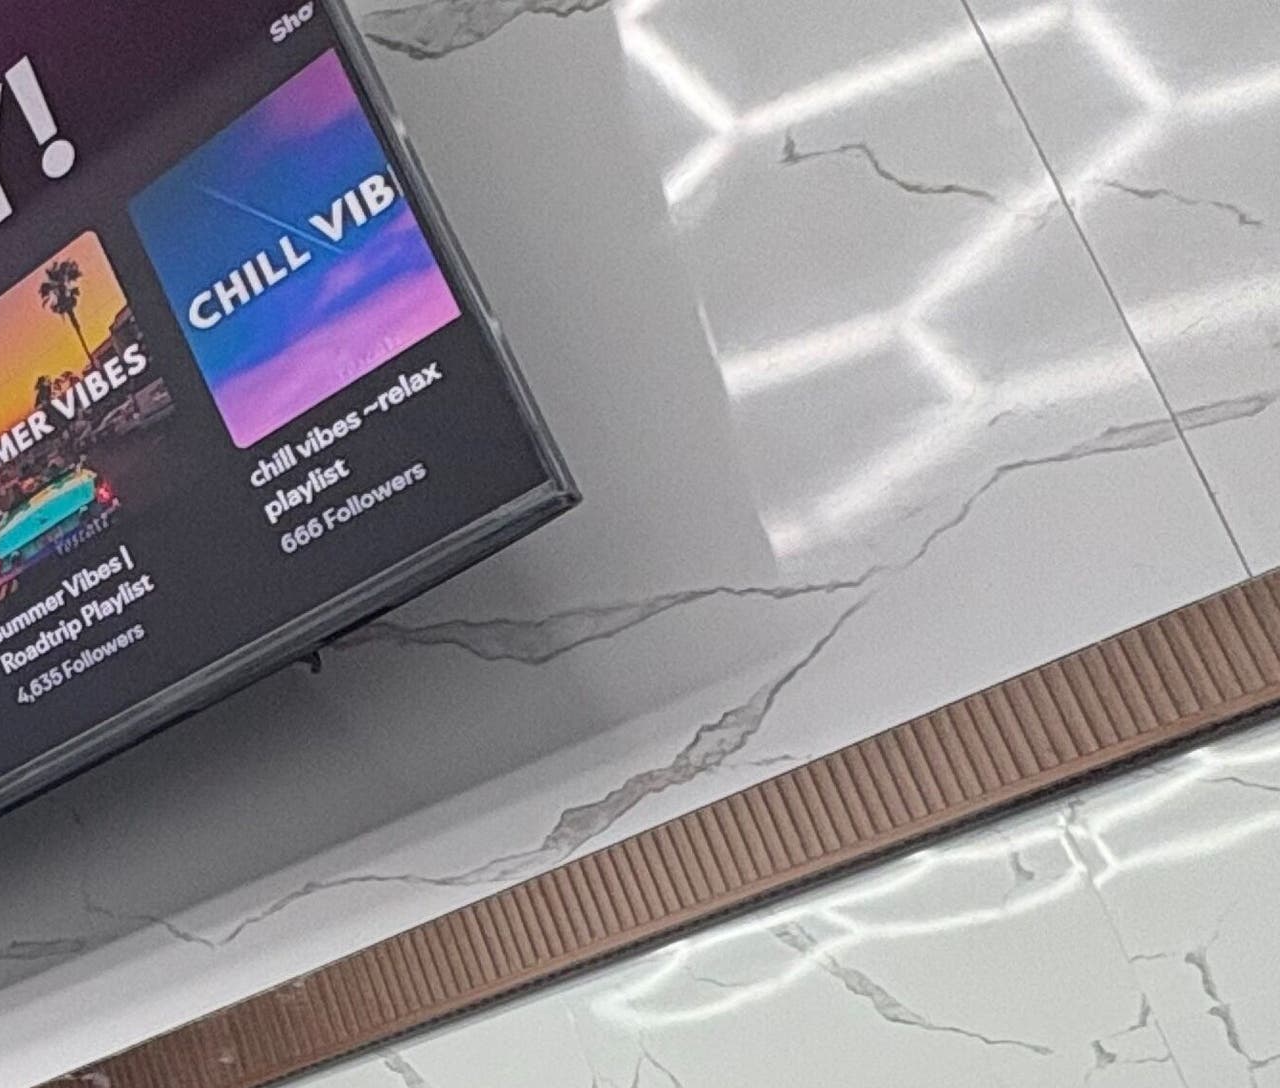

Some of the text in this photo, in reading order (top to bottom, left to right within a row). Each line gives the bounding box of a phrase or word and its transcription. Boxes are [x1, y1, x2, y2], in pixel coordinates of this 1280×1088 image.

[188, 235, 312, 329] CHILL
[51, 343, 148, 421] VIBES
[250, 443, 298, 488] chill
[296, 411, 362, 459] vibes
[264, 459, 350, 525] playlist
[280, 462, 427, 554] 666 Followers
[61, 555, 123, 598] Vibes
[0, 574, 155, 675] Roadtrip Playlist
[17, 623, 145, 704] 4,635 Followers
